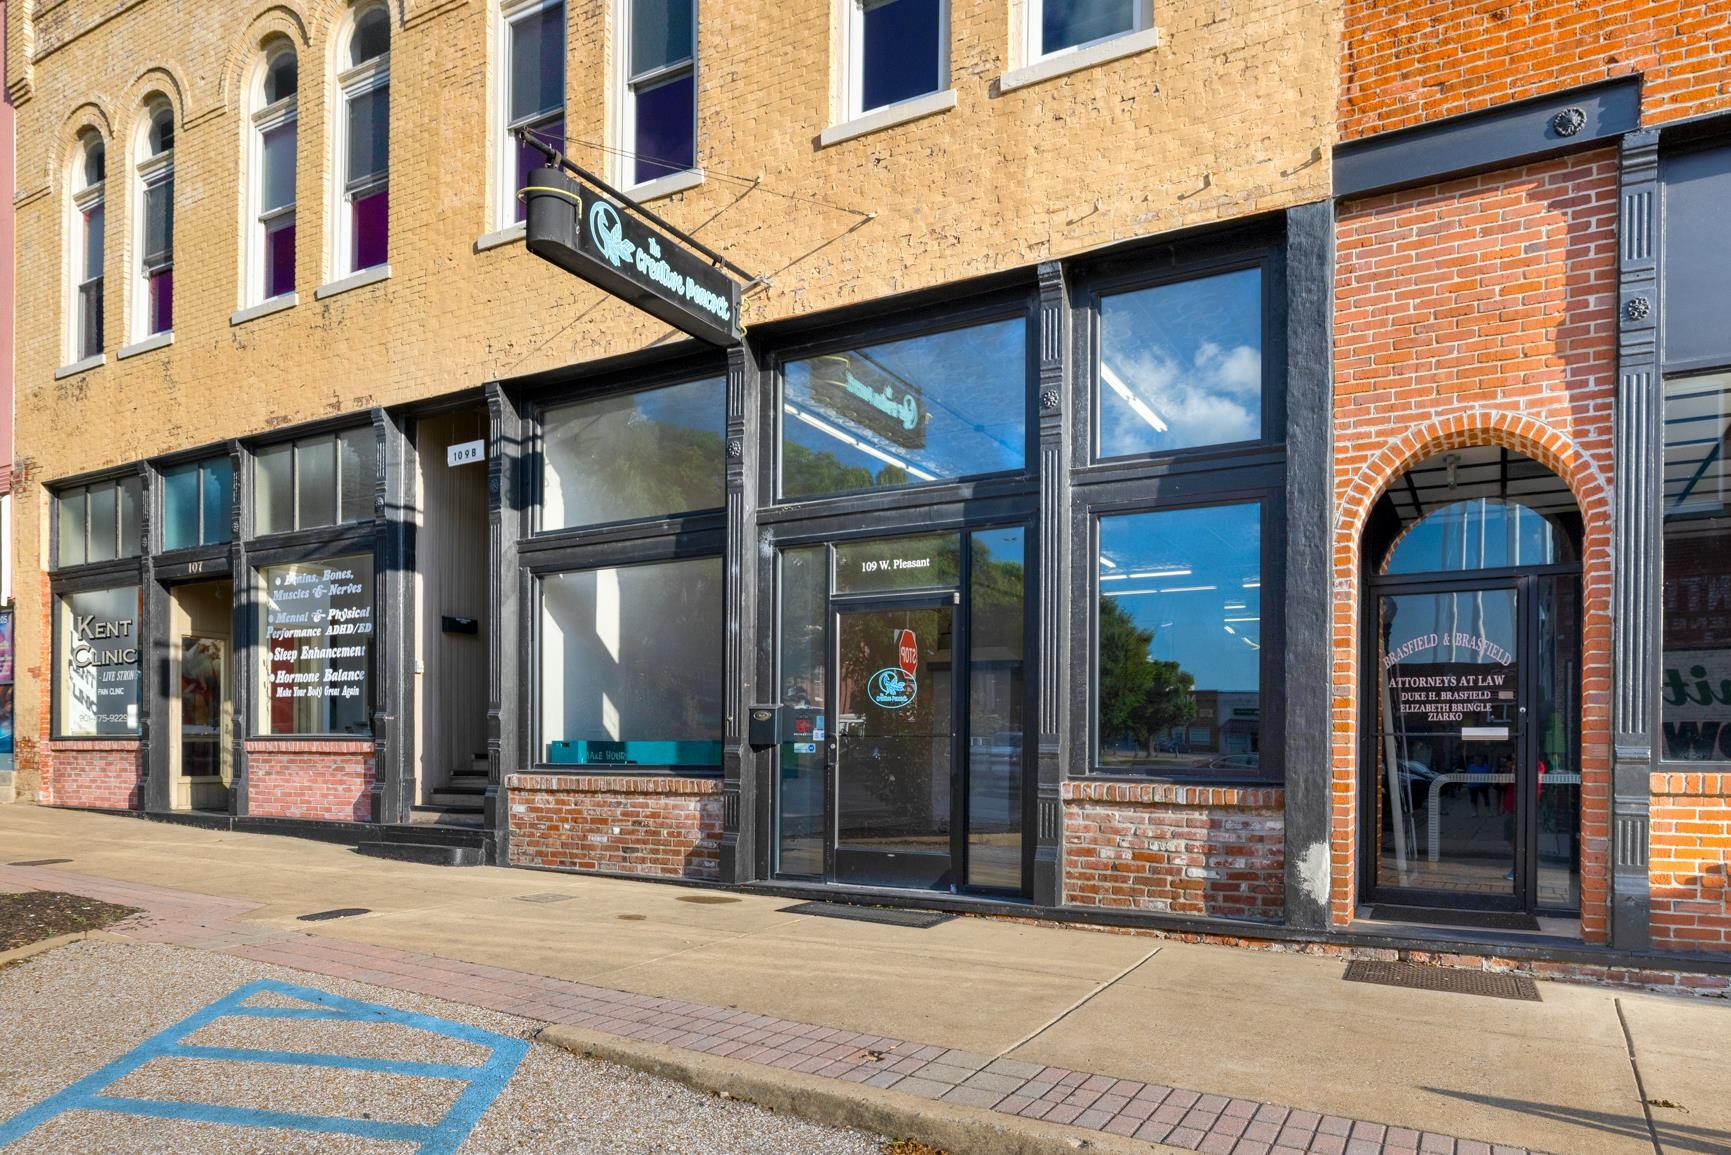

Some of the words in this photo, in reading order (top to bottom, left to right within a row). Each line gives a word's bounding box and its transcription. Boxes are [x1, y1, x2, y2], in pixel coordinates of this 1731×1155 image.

[636, 247, 685, 295] Creative
[454, 448, 477, 461] 109B
[188, 561, 204, 574] 107
[862, 561, 878, 572] 109
[879, 560, 891, 570] W.
[893, 558, 930, 569] Pleasant
[322, 569, 354, 581] Bones,
[273, 589, 310, 601] Muscles
[312, 585, 328, 598] &
[328, 583, 362, 596] Nerves
[275, 612, 308, 623] Mental
[311, 609, 326, 622] &
[327, 607, 371, 621] Physical
[77, 615, 132, 641] KENT
[266, 626, 321, 640] Performance
[325, 623, 372, 635] ADHD/ED
[73, 644, 139, 668] CLINIC
[274, 647, 298, 662] Sleep
[301, 646, 366, 659] Enhancement
[1383, 633, 1438, 670] BRASFIELD
[1443, 633, 1450, 645] &
[1455, 632, 1512, 666] BRASFIELD
[102, 671, 118, 681] LIVE
[275, 671, 320, 683] Hormone
[323, 669, 365, 682] Balance
[1389, 676, 1456, 688] ATTORNEYS
[1459, 676, 1475, 686] AT
[1478, 675, 1505, 686] LAW
[276, 687, 292, 697] Make
[293, 686, 306, 696] Your
[307, 686, 323, 698] Body
[324, 686, 340, 696] Great
[341, 685, 359, 698] Again
[1401, 692, 1426, 701] DUKE
[1428, 691, 1438, 700] H.
[1440, 690, 1491, 700] BRASFIELD
[1400, 703, 1449, 712] ELIZABETH
[1451, 702, 1492, 712] BRINGLE
[1428, 712, 1463, 721] ZIARKO
